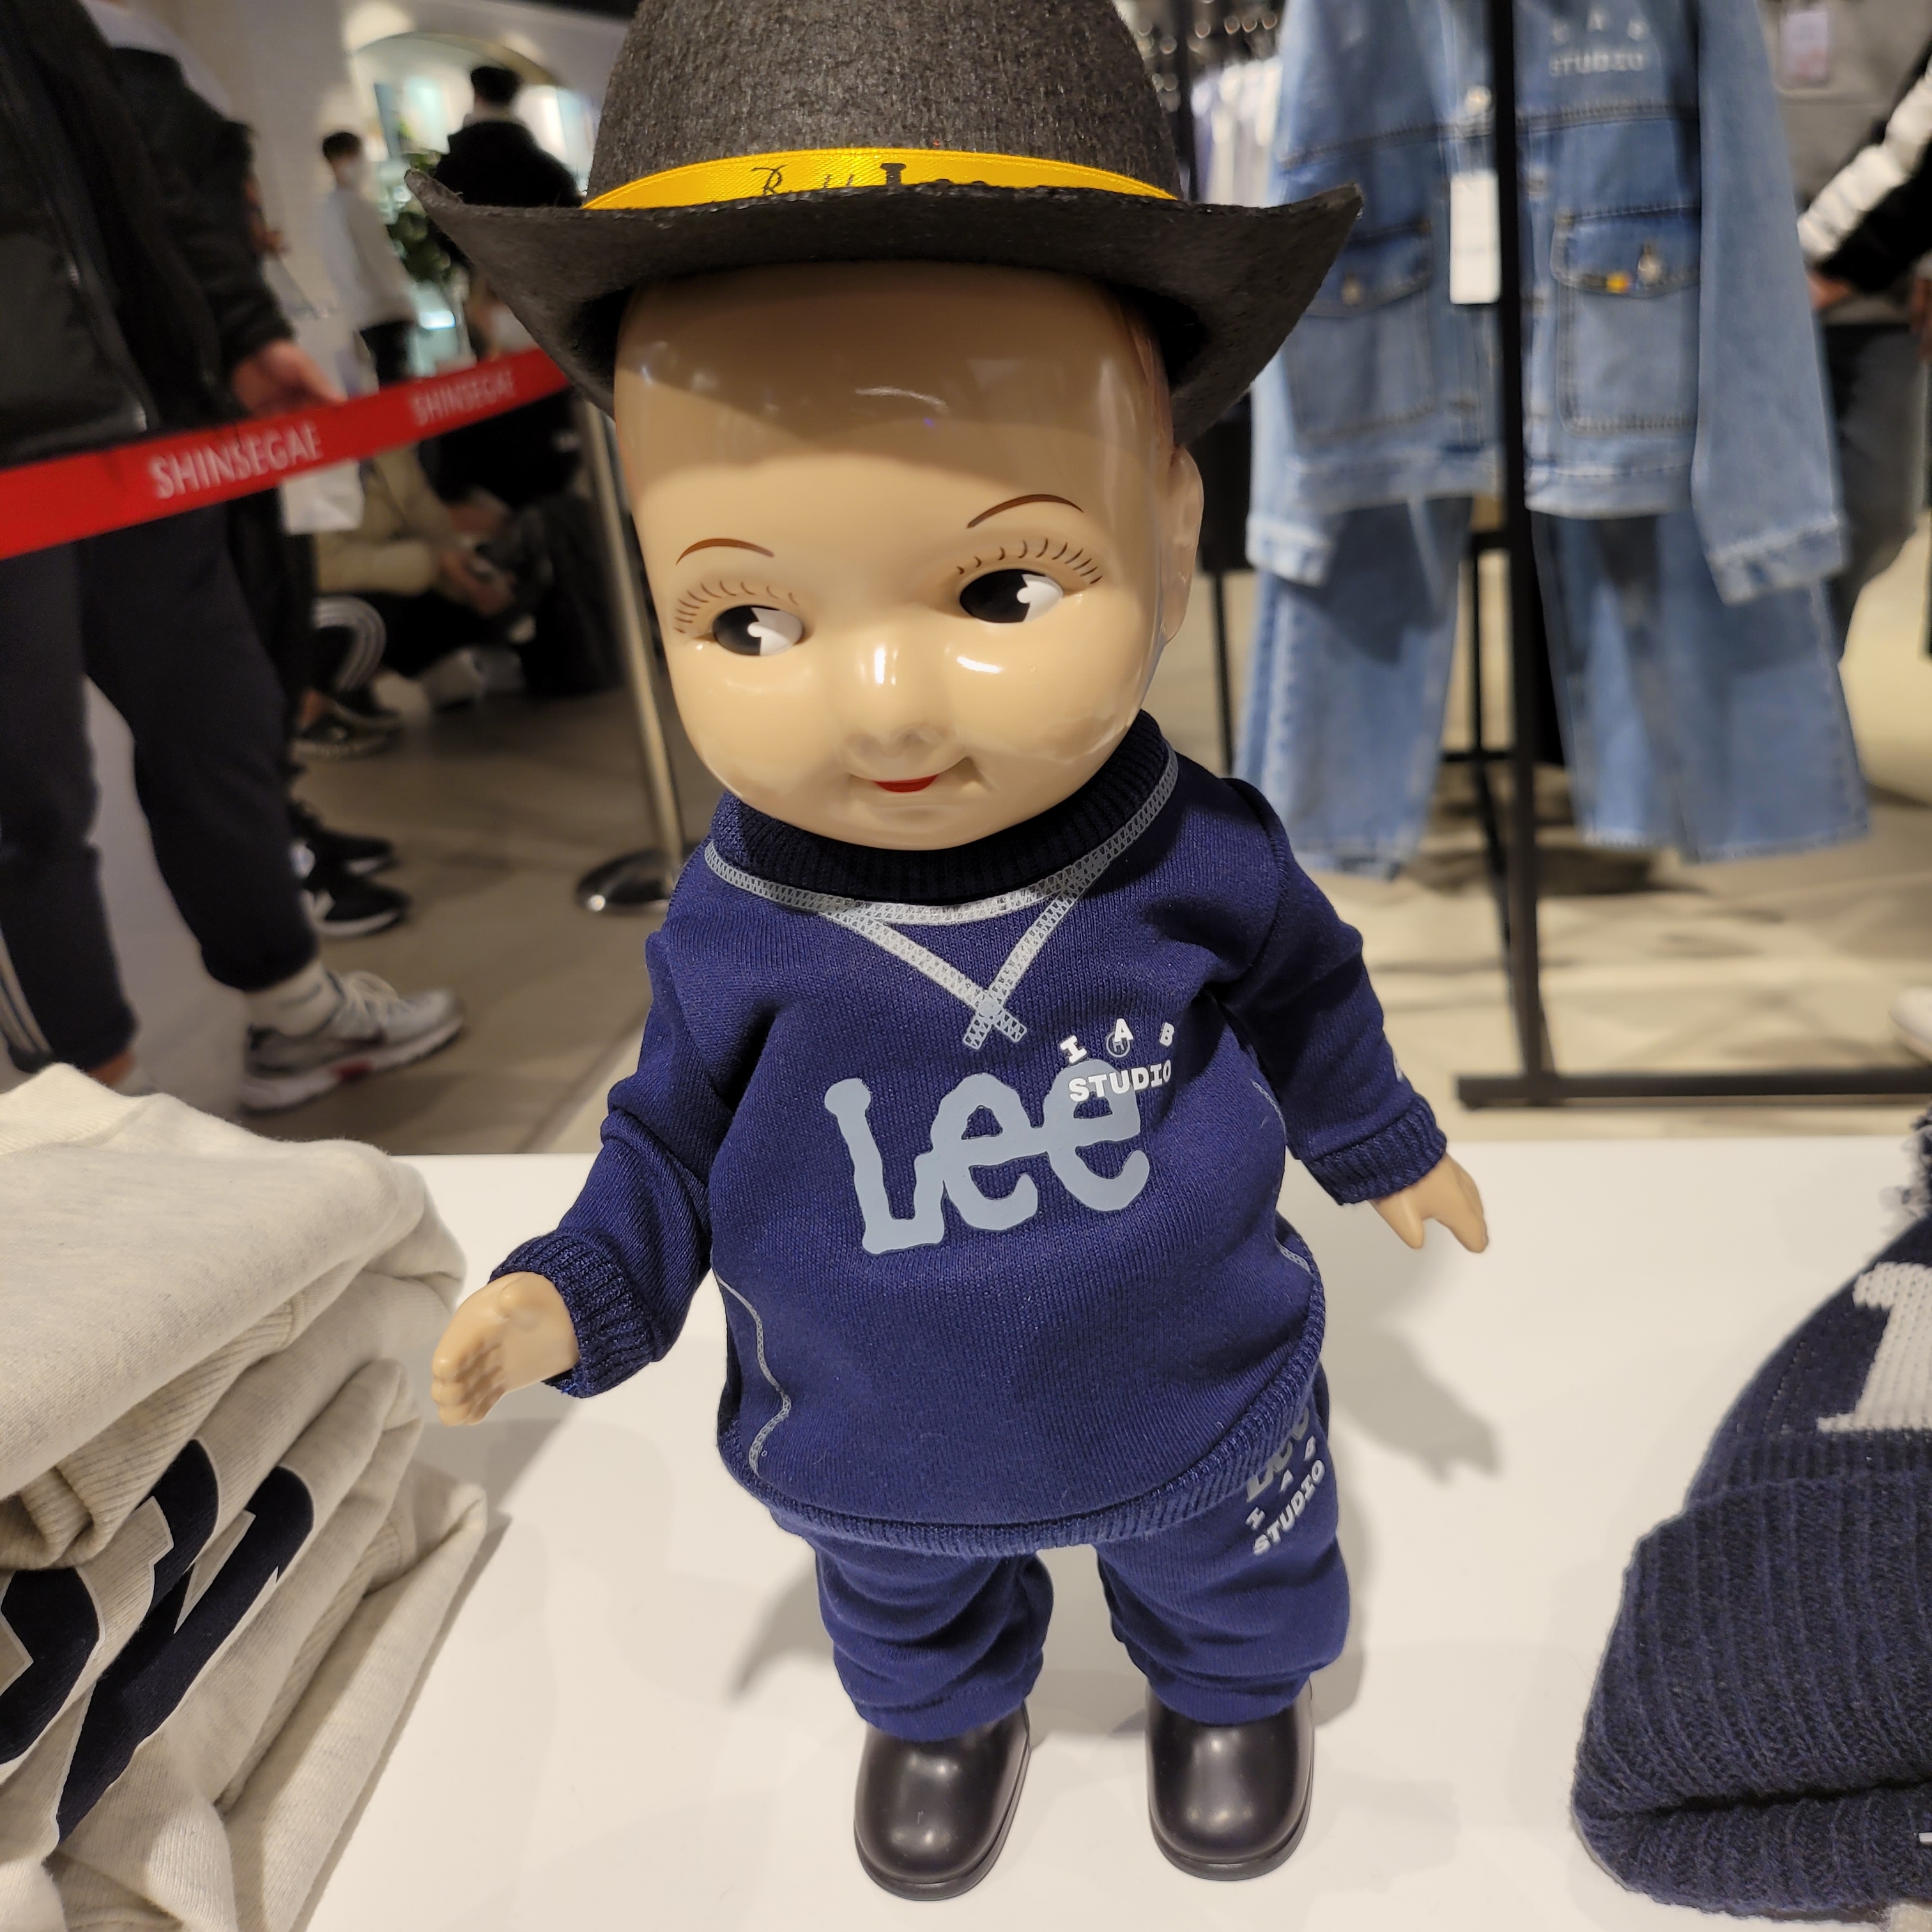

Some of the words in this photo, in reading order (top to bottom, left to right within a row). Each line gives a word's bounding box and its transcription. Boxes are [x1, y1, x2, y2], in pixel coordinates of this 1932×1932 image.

[412, 372, 515, 425] SHINSEGAE
[151, 422, 321, 500] SHINSEGAE
[1069, 1059, 1172, 1102] STUDIO
[824, 1058, 1150, 1254] Lee
[1254, 1459, 1325, 1556] STUDIO
